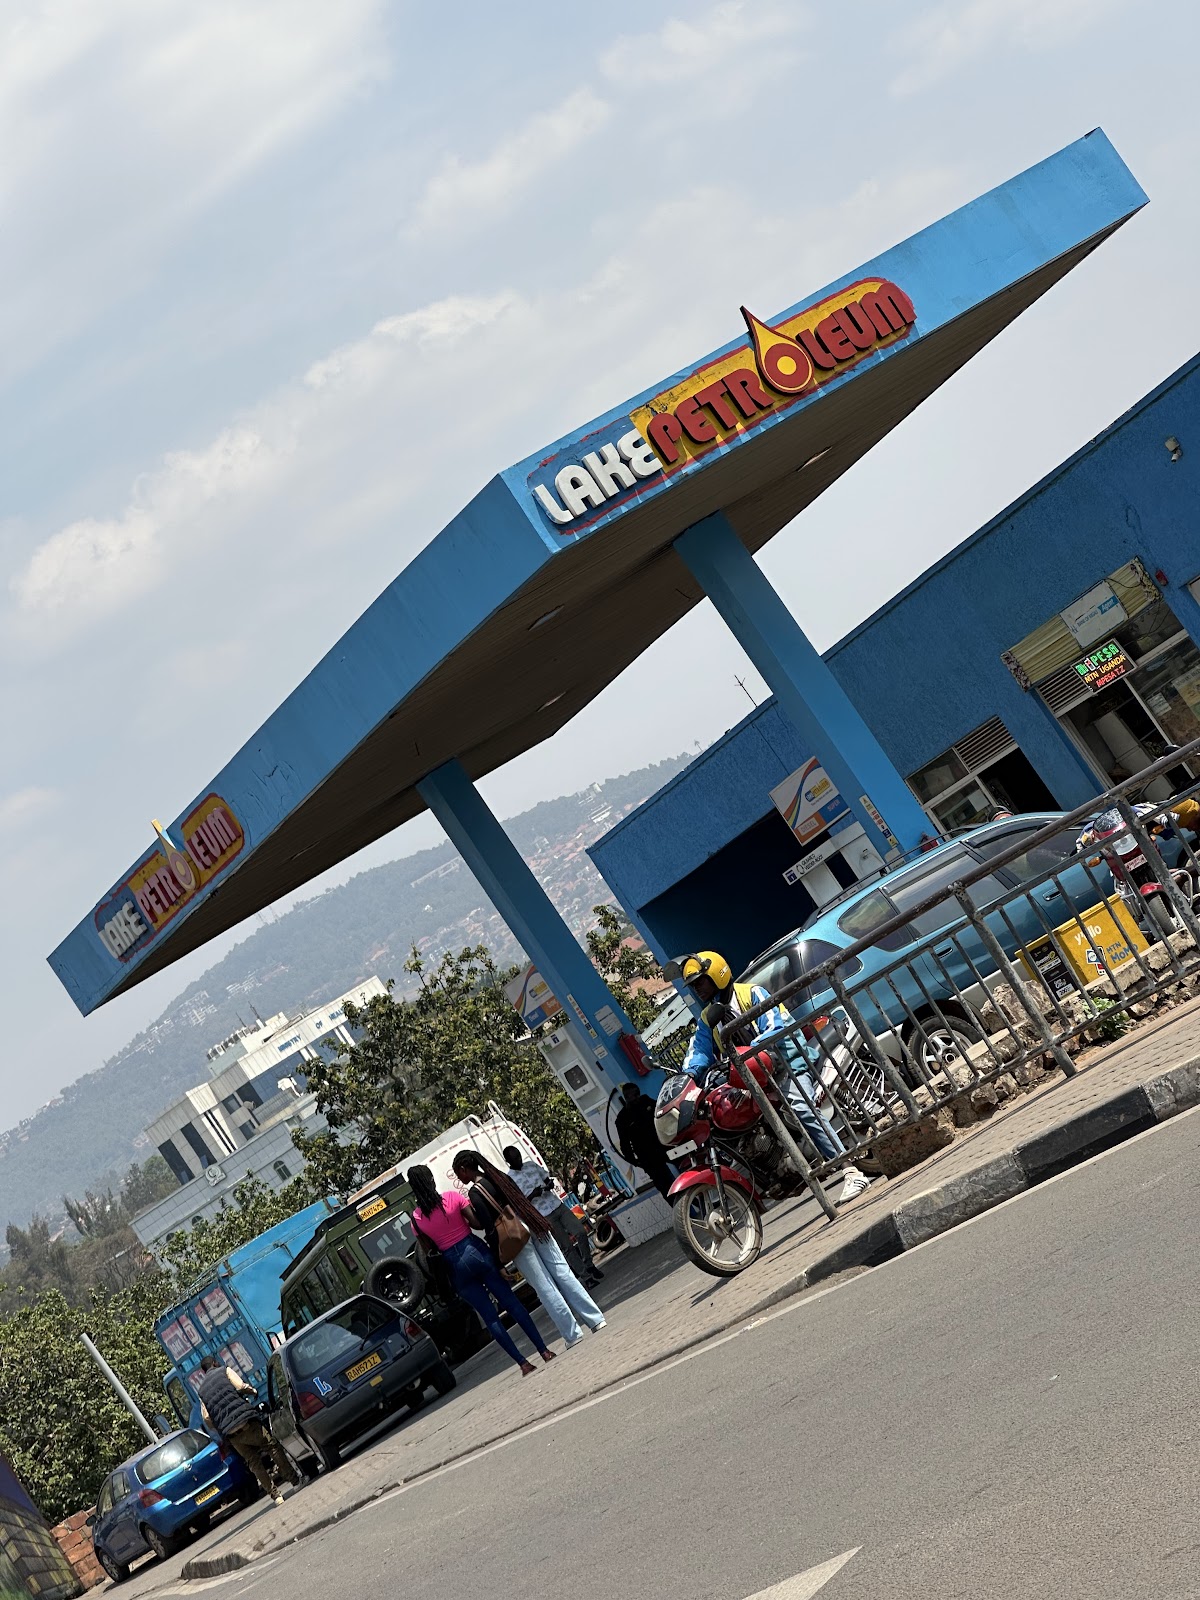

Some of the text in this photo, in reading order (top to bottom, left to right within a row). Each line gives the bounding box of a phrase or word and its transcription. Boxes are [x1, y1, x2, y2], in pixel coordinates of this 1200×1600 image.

[533, 282, 918, 525] LAKE PETROLEUM
[1084, 655, 1126, 683] MTN UGANDA
[1096, 671, 1117, 687] MPESA
[800, 819, 817, 833] DIESEL
[98, 806, 241, 959] LAKE PETROLEUM
[1106, 941, 1122, 954] MTN
[315, 1020, 323, 1029] OF
[347, 1356, 378, 1380] RAH571Z
[313, 1376, 332, 1396] L
